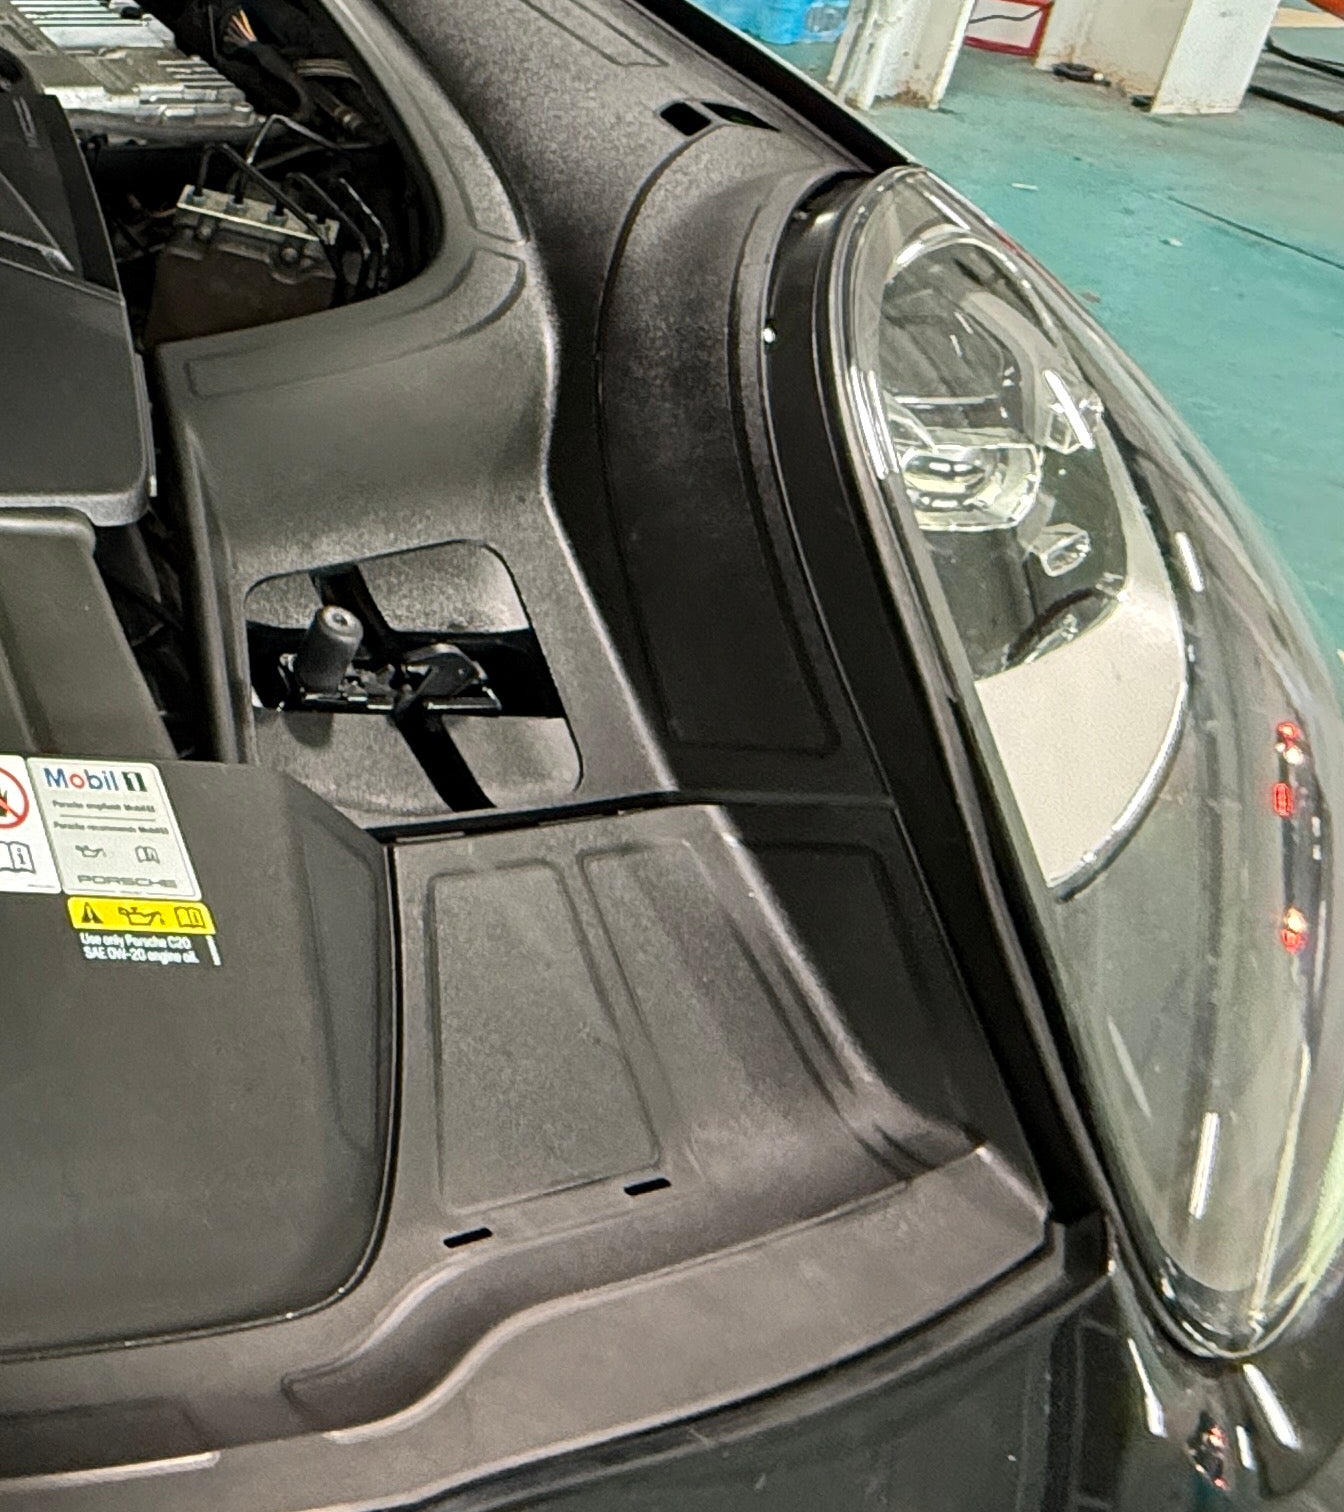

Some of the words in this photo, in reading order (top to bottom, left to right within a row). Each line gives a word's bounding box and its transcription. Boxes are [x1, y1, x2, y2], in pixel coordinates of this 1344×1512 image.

[43, 767, 119, 791] Mobil
[77, 875, 178, 888] PORSCHE
[83, 946, 108, 959] SAE
